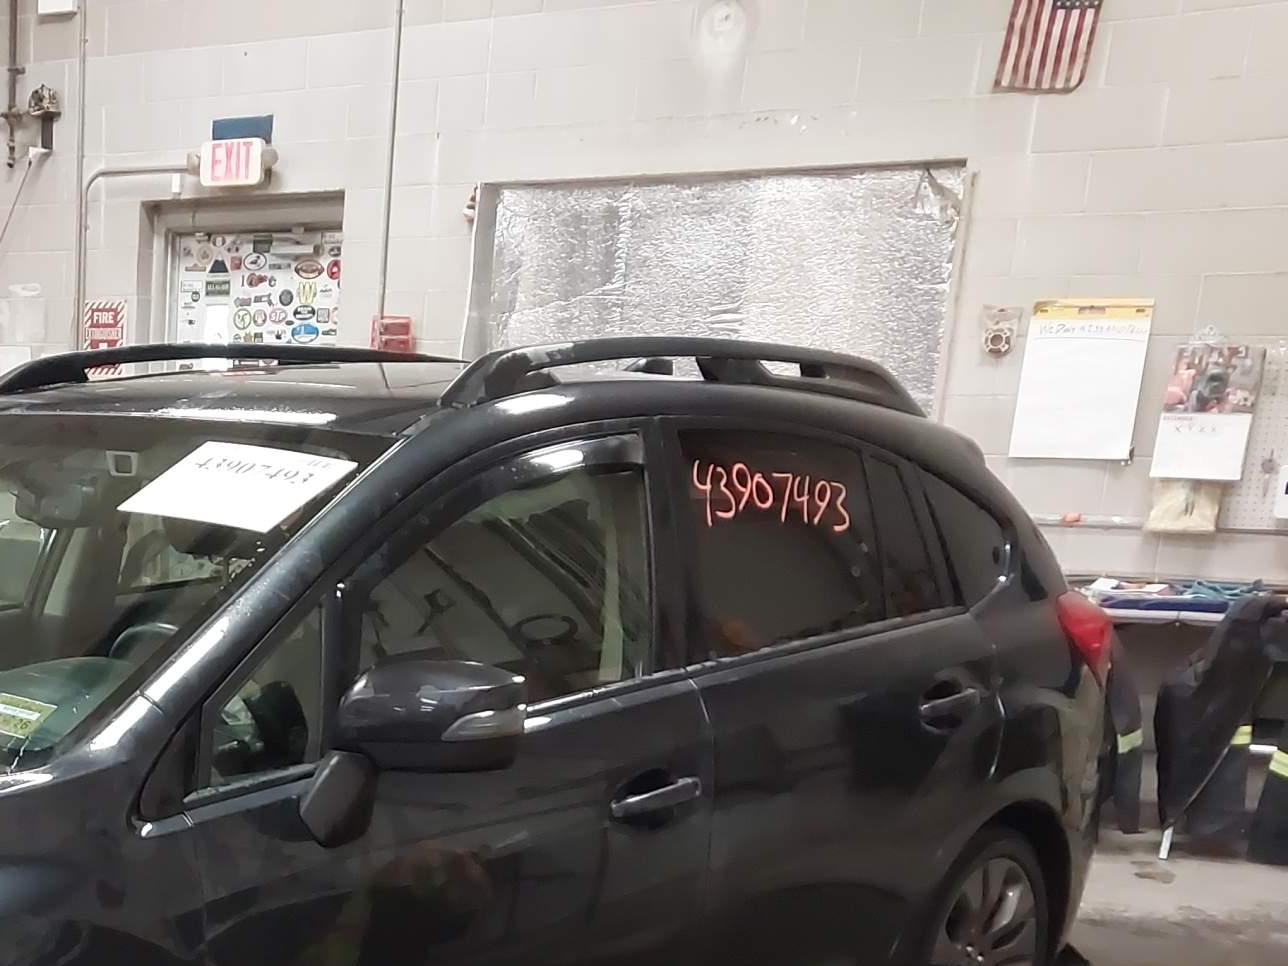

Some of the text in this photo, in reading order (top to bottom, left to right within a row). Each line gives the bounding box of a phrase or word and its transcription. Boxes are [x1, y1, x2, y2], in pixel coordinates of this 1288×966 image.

[211, 141, 253, 181] EXIT
[93, 311, 115, 324] FIRE
[693, 460, 850, 531] 43907493
